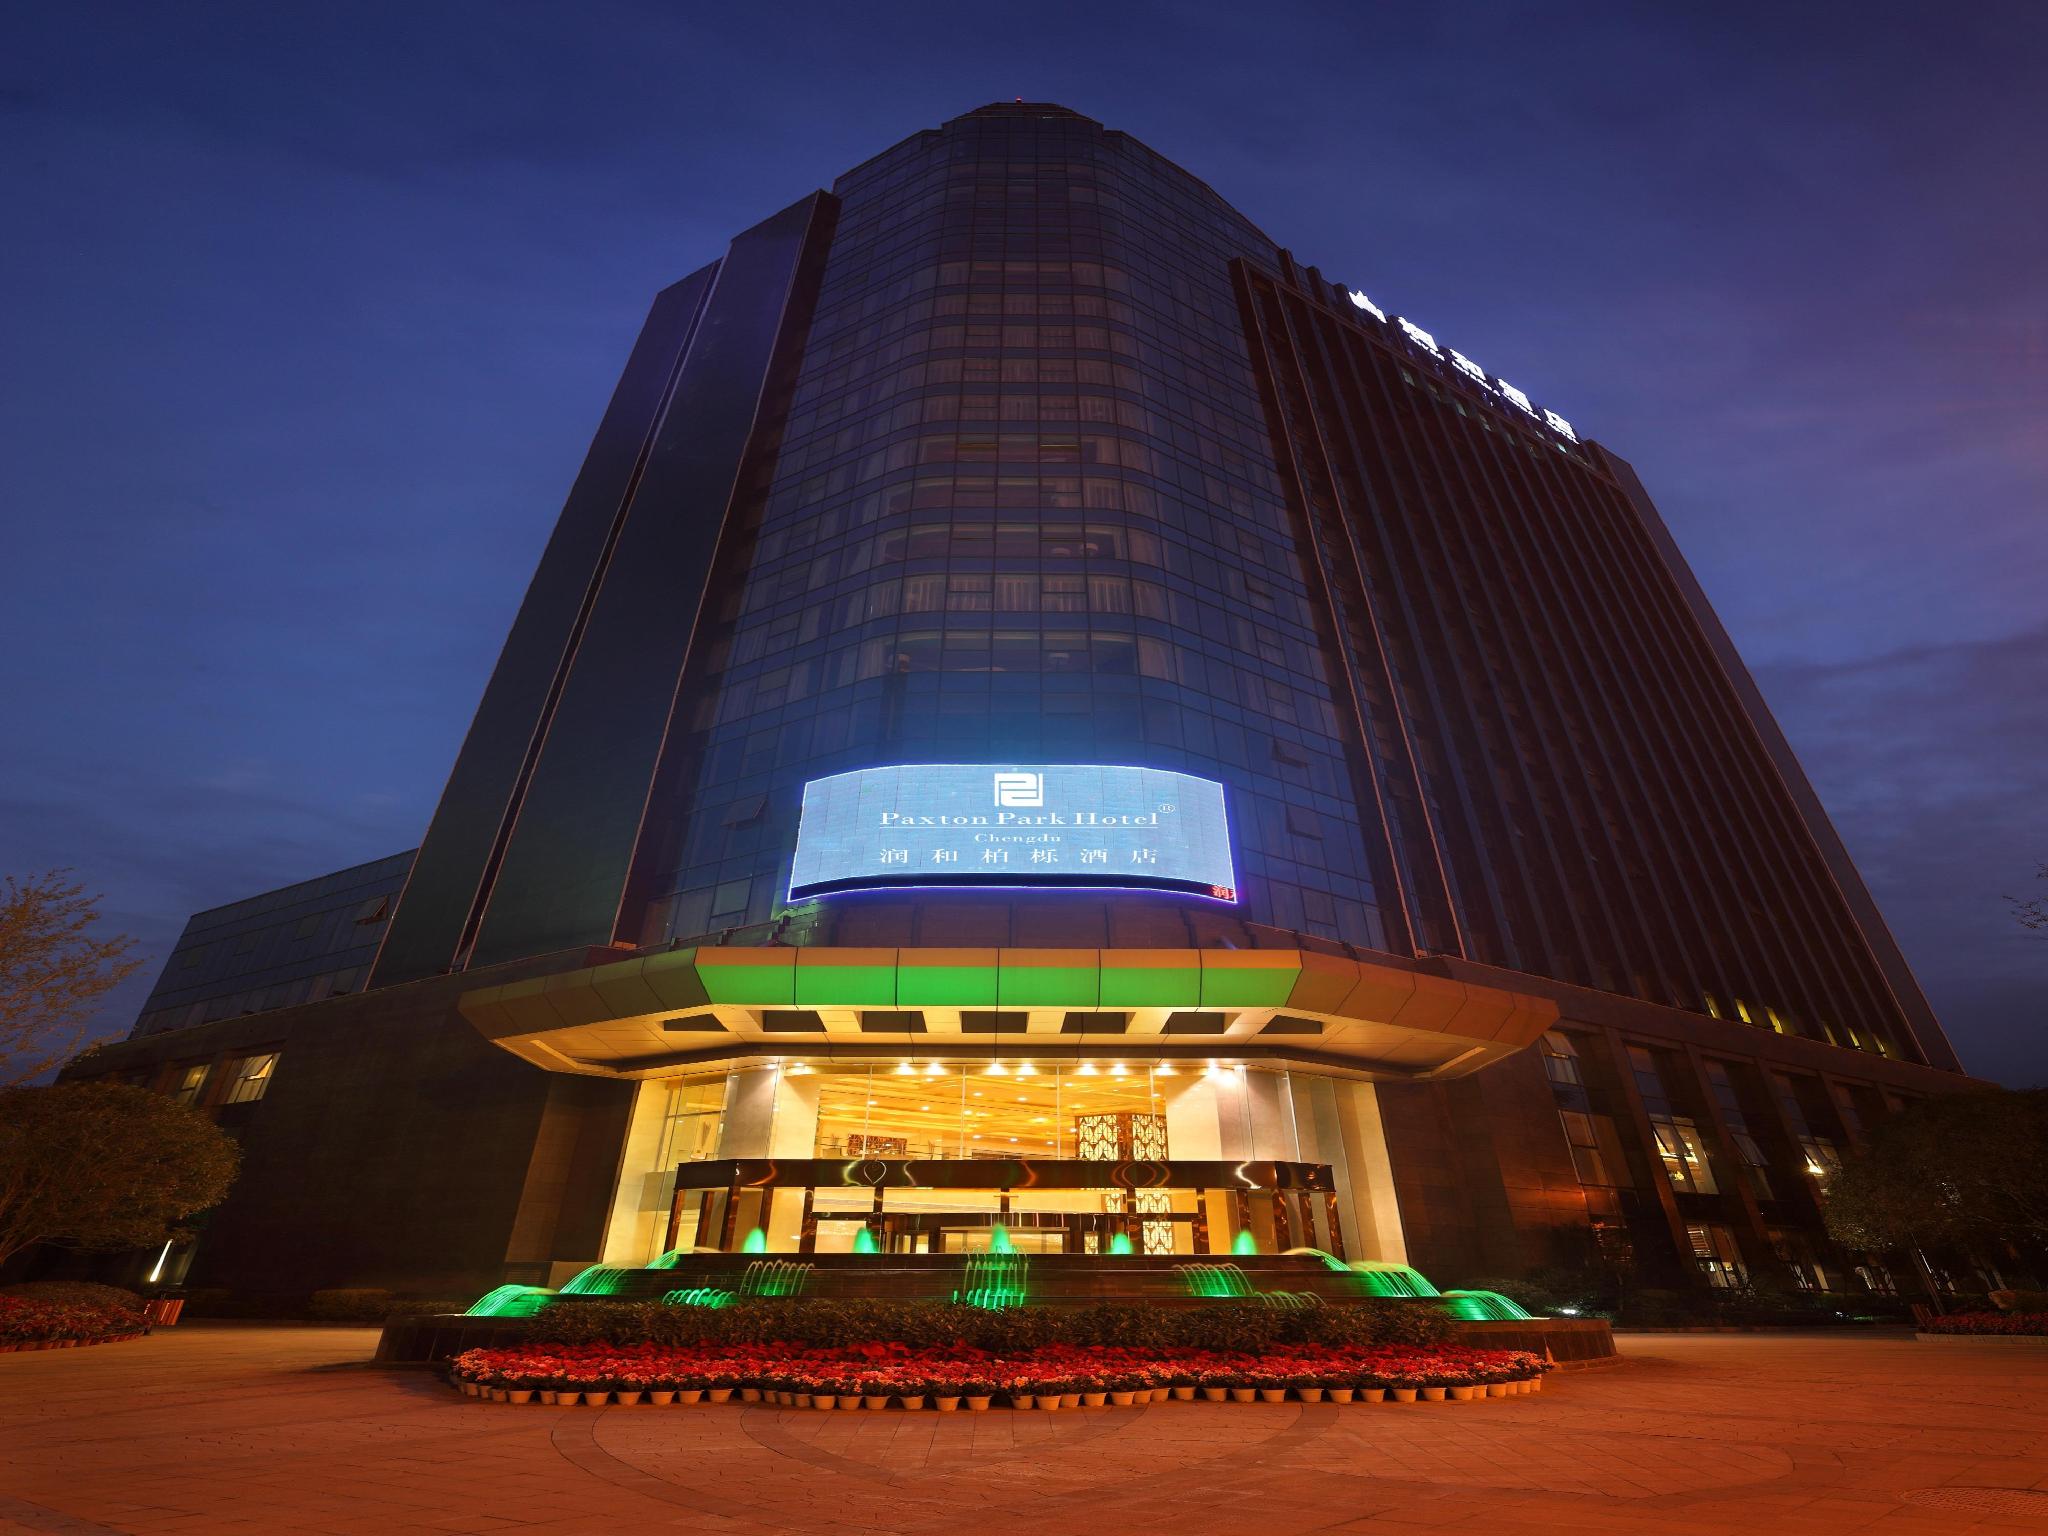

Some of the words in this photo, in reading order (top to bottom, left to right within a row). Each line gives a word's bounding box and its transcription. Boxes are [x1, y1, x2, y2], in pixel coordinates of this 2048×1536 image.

[879, 812, 989, 825] Paxton
[995, 812, 1067, 825] Park
[1072, 812, 1160, 825] Hotel
[974, 833, 1061, 845] Chengdu
[879, 848, 1160, 864] 润和柏栎酒店
